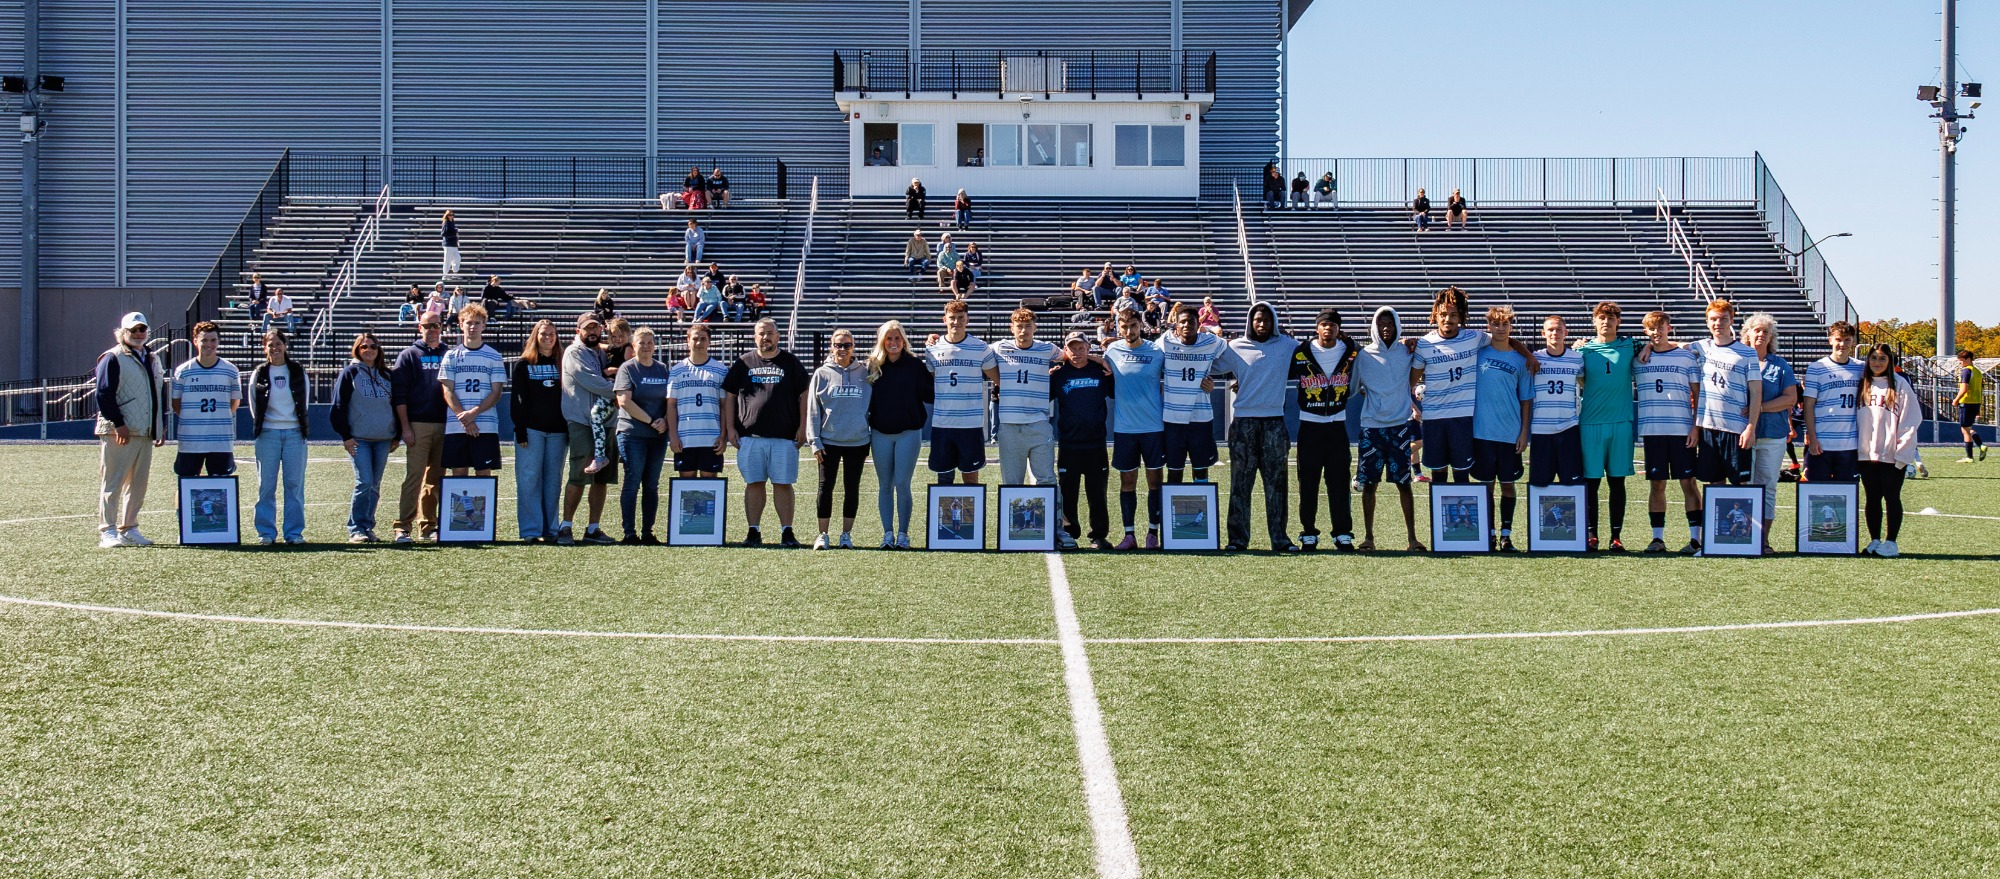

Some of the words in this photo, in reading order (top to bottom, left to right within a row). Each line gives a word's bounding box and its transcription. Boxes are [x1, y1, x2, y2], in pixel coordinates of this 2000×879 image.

[1004, 356, 1043, 366] ONONDAGA
[1171, 353, 1207, 361] ONONDAGA
[1432, 350, 1472, 364] ONONDAGA
[748, 366, 785, 377] ONONDAGA
[1181, 367, 1196, 382] 18
[1448, 366, 1463, 382] 19
[1605, 361, 1611, 374] 1
[1641, 365, 1680, 374] ONONDAGA
[681, 379, 716, 388] ONONDAGA
[949, 372, 958, 387] 5
[1016, 369, 1029, 384] 11
[1711, 371, 1726, 388] 44
[189, 384, 227, 393] ONONDAGA
[465, 378, 480, 393] 22
[1547, 380, 1564, 395] 33
[1655, 378, 1664, 393] 6
[200, 398, 217, 413] 23
[695, 393, 703, 407] 8
[1839, 393, 1854, 409] 70
